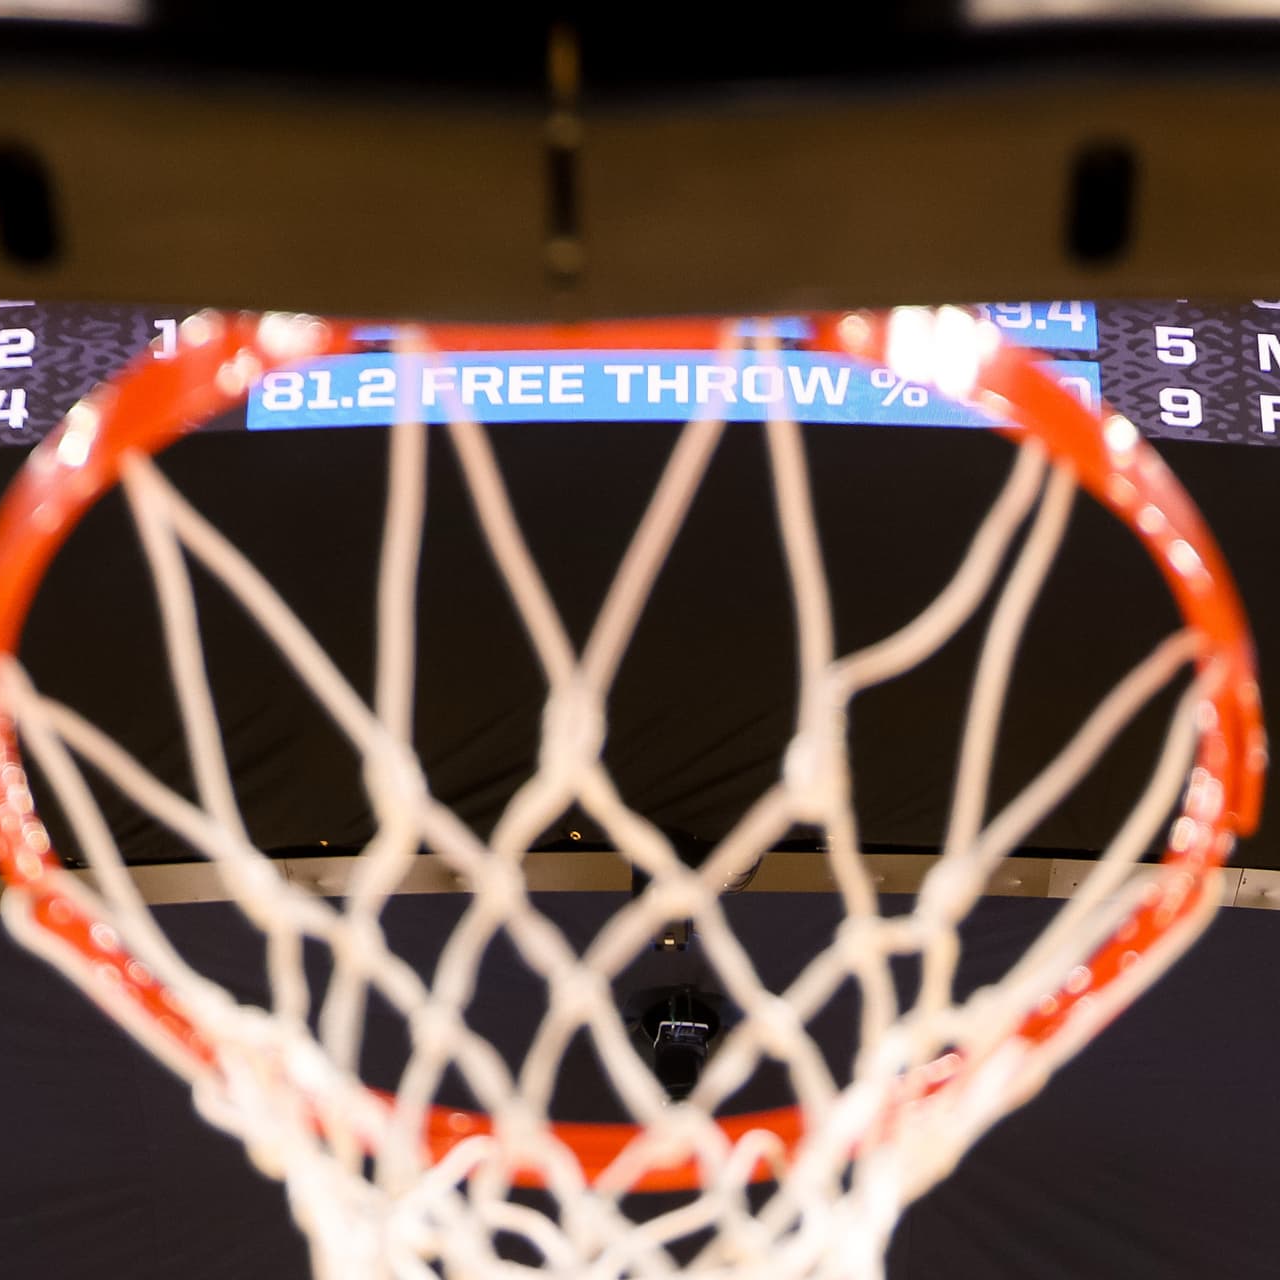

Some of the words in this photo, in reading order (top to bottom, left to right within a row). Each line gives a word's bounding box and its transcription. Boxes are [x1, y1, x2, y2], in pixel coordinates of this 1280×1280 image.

[978, 300, 1087, 332] 9.4
[1155, 325, 1197, 367] 5
[262, 367, 397, 413] 81.2
[421, 367, 587, 407] FREE
[604, 364, 852, 407] THROW
[871, 367, 930, 408] %
[1159, 387, 1203, 429] 9
